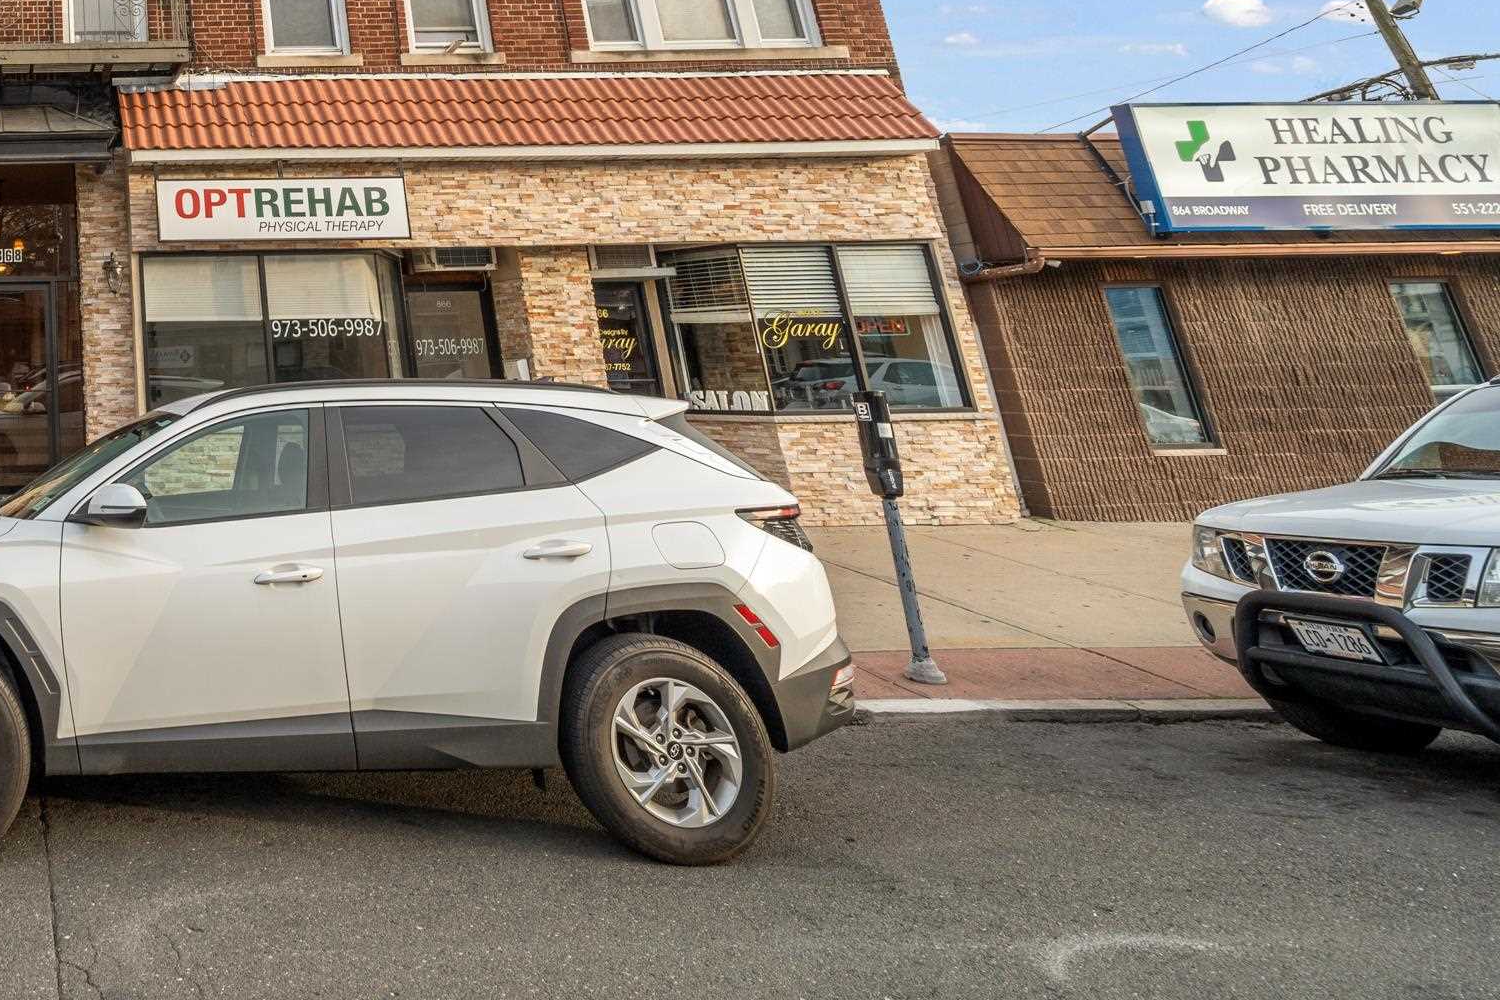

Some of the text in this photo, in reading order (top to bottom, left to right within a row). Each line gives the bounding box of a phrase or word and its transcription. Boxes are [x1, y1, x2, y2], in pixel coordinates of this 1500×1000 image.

[1265, 116, 1453, 144] HEALING
[1253, 154, 1493, 184] PHARMACY
[174, 186, 390, 219] OPTREHAB
[1172, 205, 1250, 216] 864 BROADWAY
[1303, 203, 1397, 216] FREE DELIVERY
[259, 220, 384, 232] PHYSICAL THERAPY
[271, 318, 383, 338] 973-506-9987
[762, 307, 842, 350] Garay
[415, 338, 485, 357] 973-506-9987
[690, 390, 770, 411] SALON
